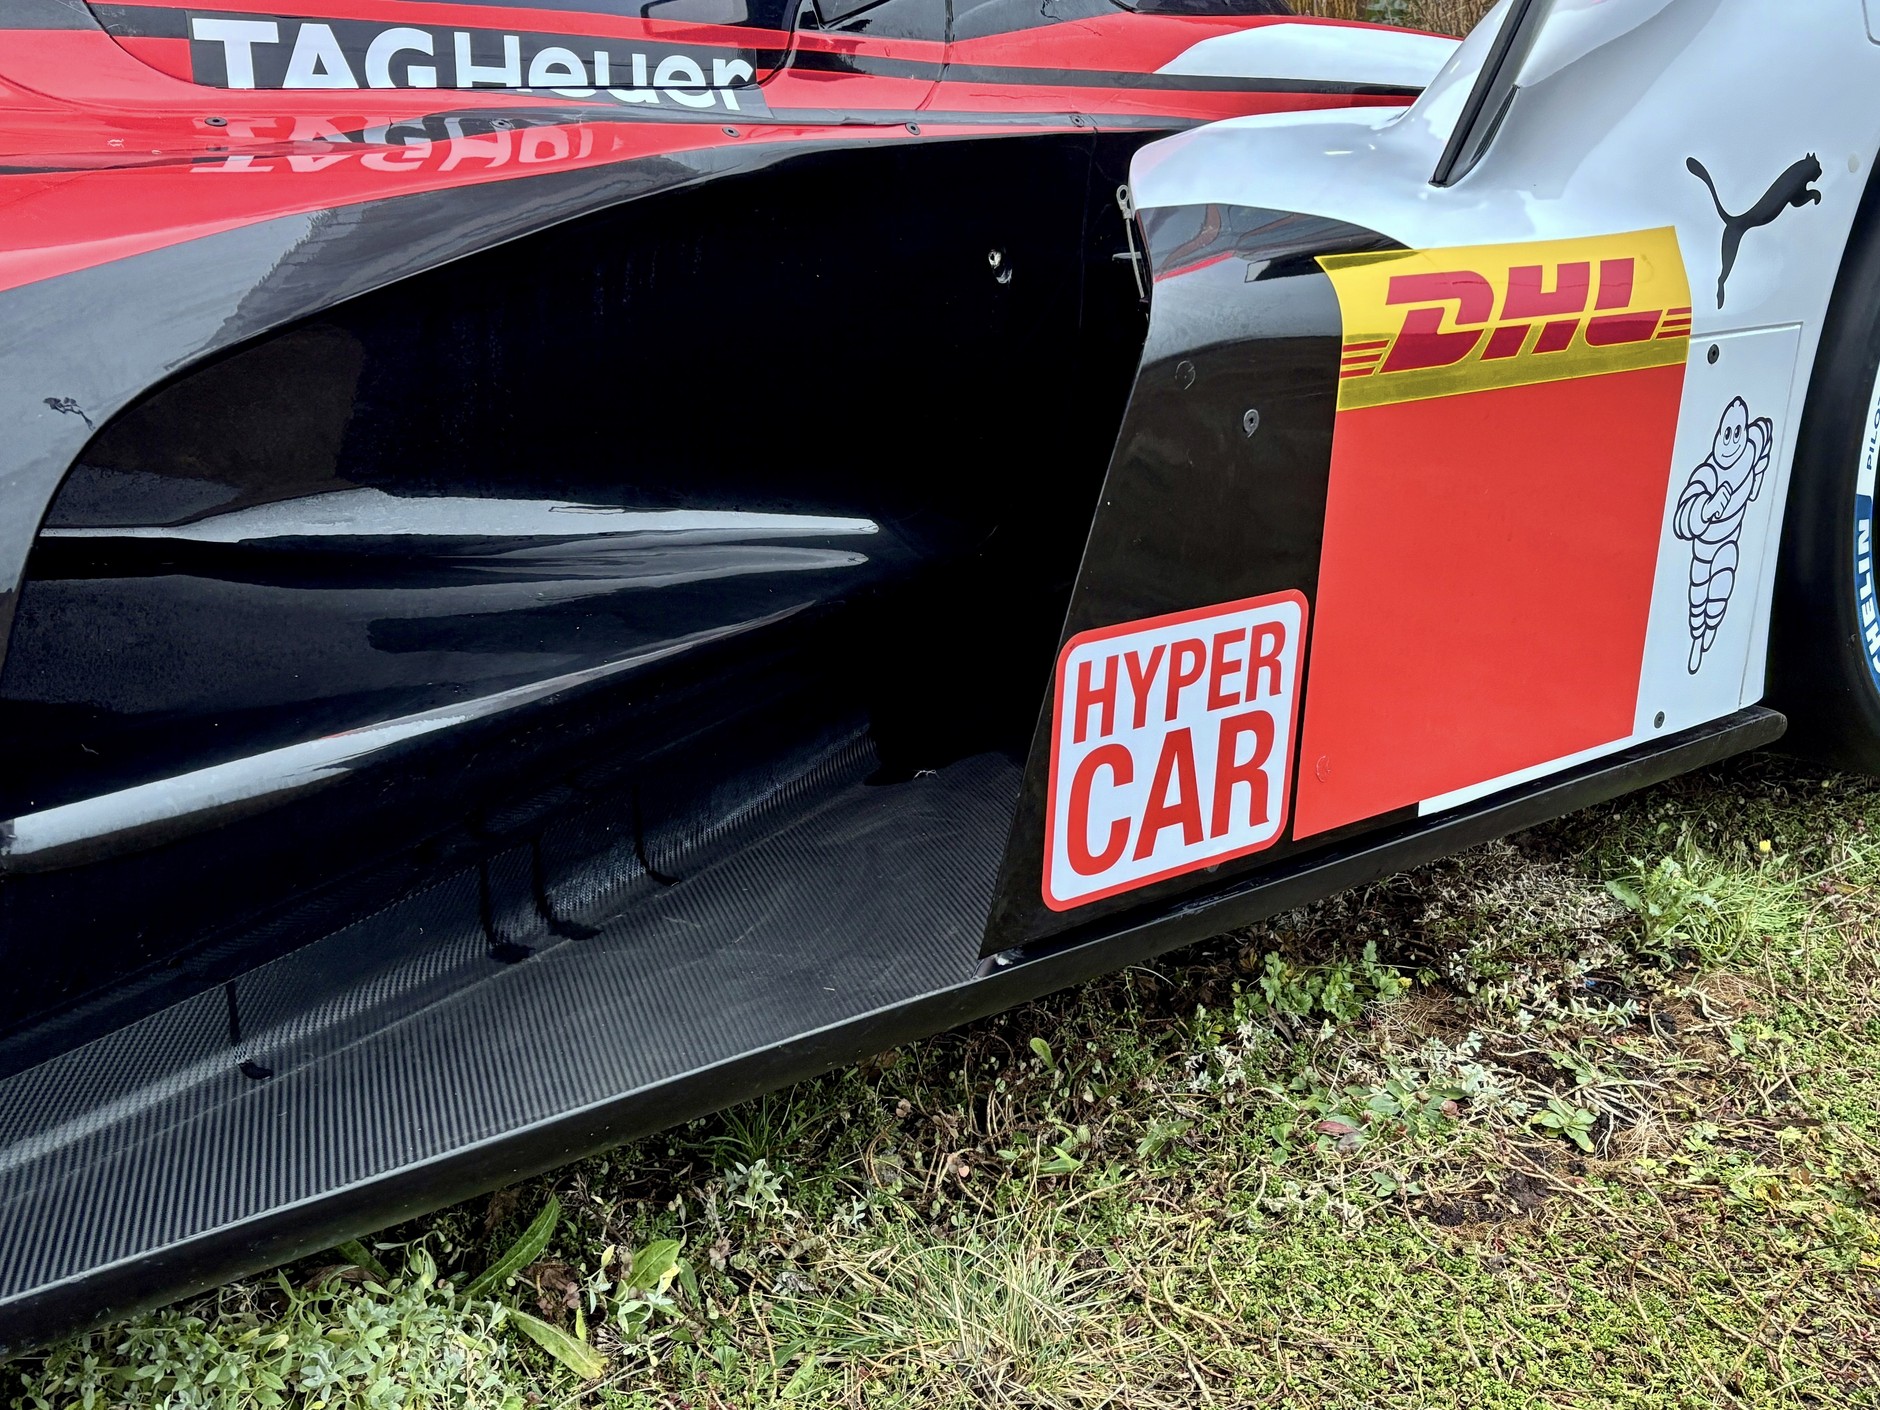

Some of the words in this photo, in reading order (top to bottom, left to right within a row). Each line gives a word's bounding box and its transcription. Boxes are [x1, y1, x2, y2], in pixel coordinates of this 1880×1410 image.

[193, 18, 437, 89] TAG
[453, 31, 754, 111] Heuer
[1379, 257, 1663, 373] DHL
[1866, 396, 1880, 470] PILO
[1073, 620, 1286, 744] HYPER
[1067, 709, 1275, 876] CAR
